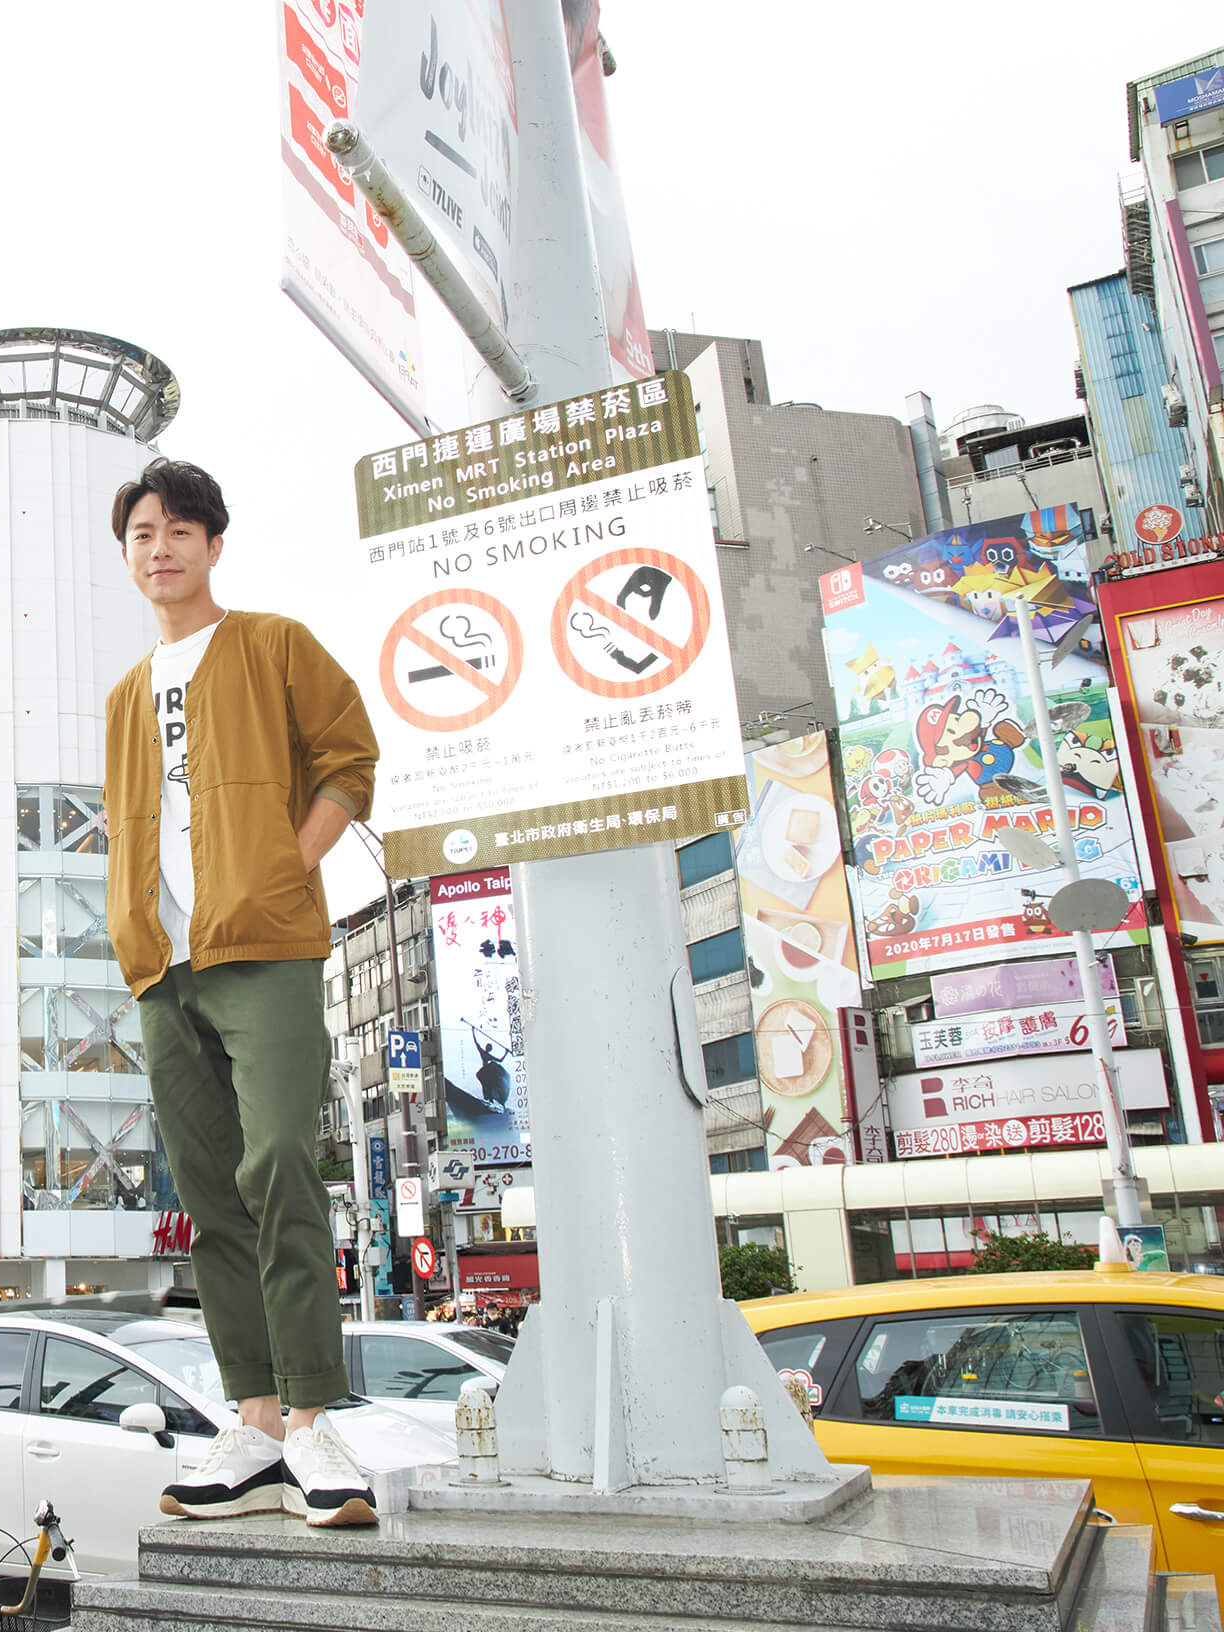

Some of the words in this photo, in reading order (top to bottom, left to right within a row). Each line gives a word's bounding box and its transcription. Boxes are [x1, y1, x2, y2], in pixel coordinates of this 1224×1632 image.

[371, 378, 669, 480] 西門捷運廣場禁菸區
[383, 475, 443, 502] Ximen
[455, 458, 500, 484] MRT
[515, 437, 592, 468] Station
[605, 419, 663, 445] Plaza
[428, 494, 456, 512] No
[466, 471, 554, 503] Smoking
[566, 456, 617, 478] Area
[369, 471, 693, 565] 西門站1號及6號出口周邊禁止吸菸
[432, 553, 473, 579] NO
[485, 516, 626, 567] SMOKING
[584, 699, 693, 733] 禁止亂丟菸蒂
[426, 737, 491, 760] 禁止吸菸
[495, 805, 678, 848] 臺北市政府衛生局、環保局
[872, 821, 975, 866] PAPER
[981, 802, 1108, 840] MARIO
[437, 879, 480, 897] Apollo
[893, 850, 1013, 892] ORIGAMI
[884, 922, 1016, 957] 2020年7月17日發售
[390, 1034, 405, 1058] P
[919, 1025, 964, 1052] 玉芙蓉
[981, 1014, 1014, 1040] 按摩
[952, 1074, 994, 1092] 李奇
[952, 1091, 996, 1112] RICH
[996, 1088, 1037, 1107] HAIR
[895, 1126, 960, 1157] 剪髮280
[936, 1404, 1002, 1420] 本車完成消毒
[1005, 1407, 1064, 1423] 請安心搭乘
